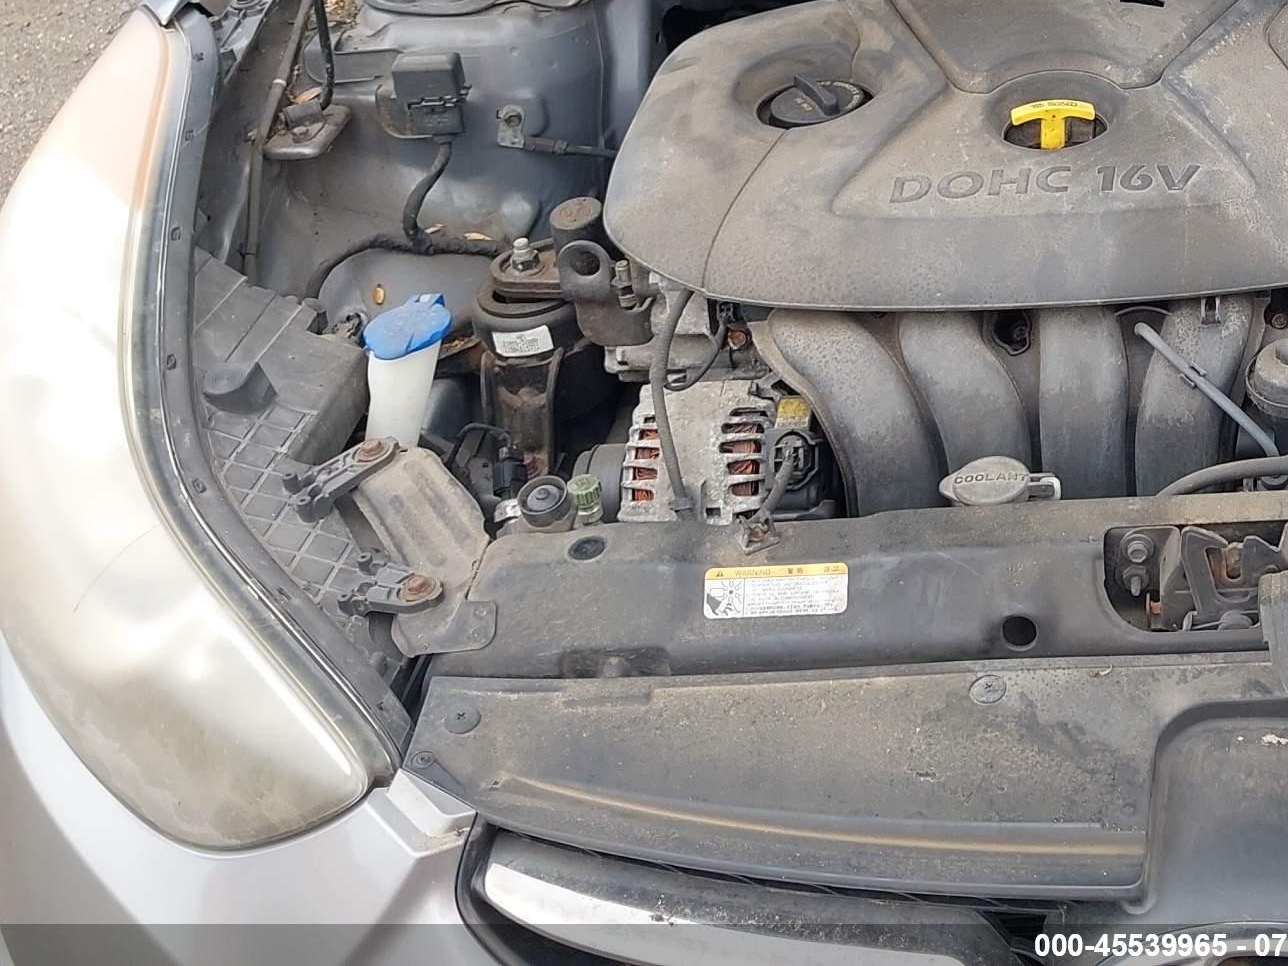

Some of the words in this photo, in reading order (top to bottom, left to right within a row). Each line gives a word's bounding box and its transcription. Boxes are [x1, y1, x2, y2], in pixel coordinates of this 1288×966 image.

[888, 166, 1073, 203] DOHC
[1097, 164, 1201, 194] 16V
[954, 472, 1026, 485] COOLANT
